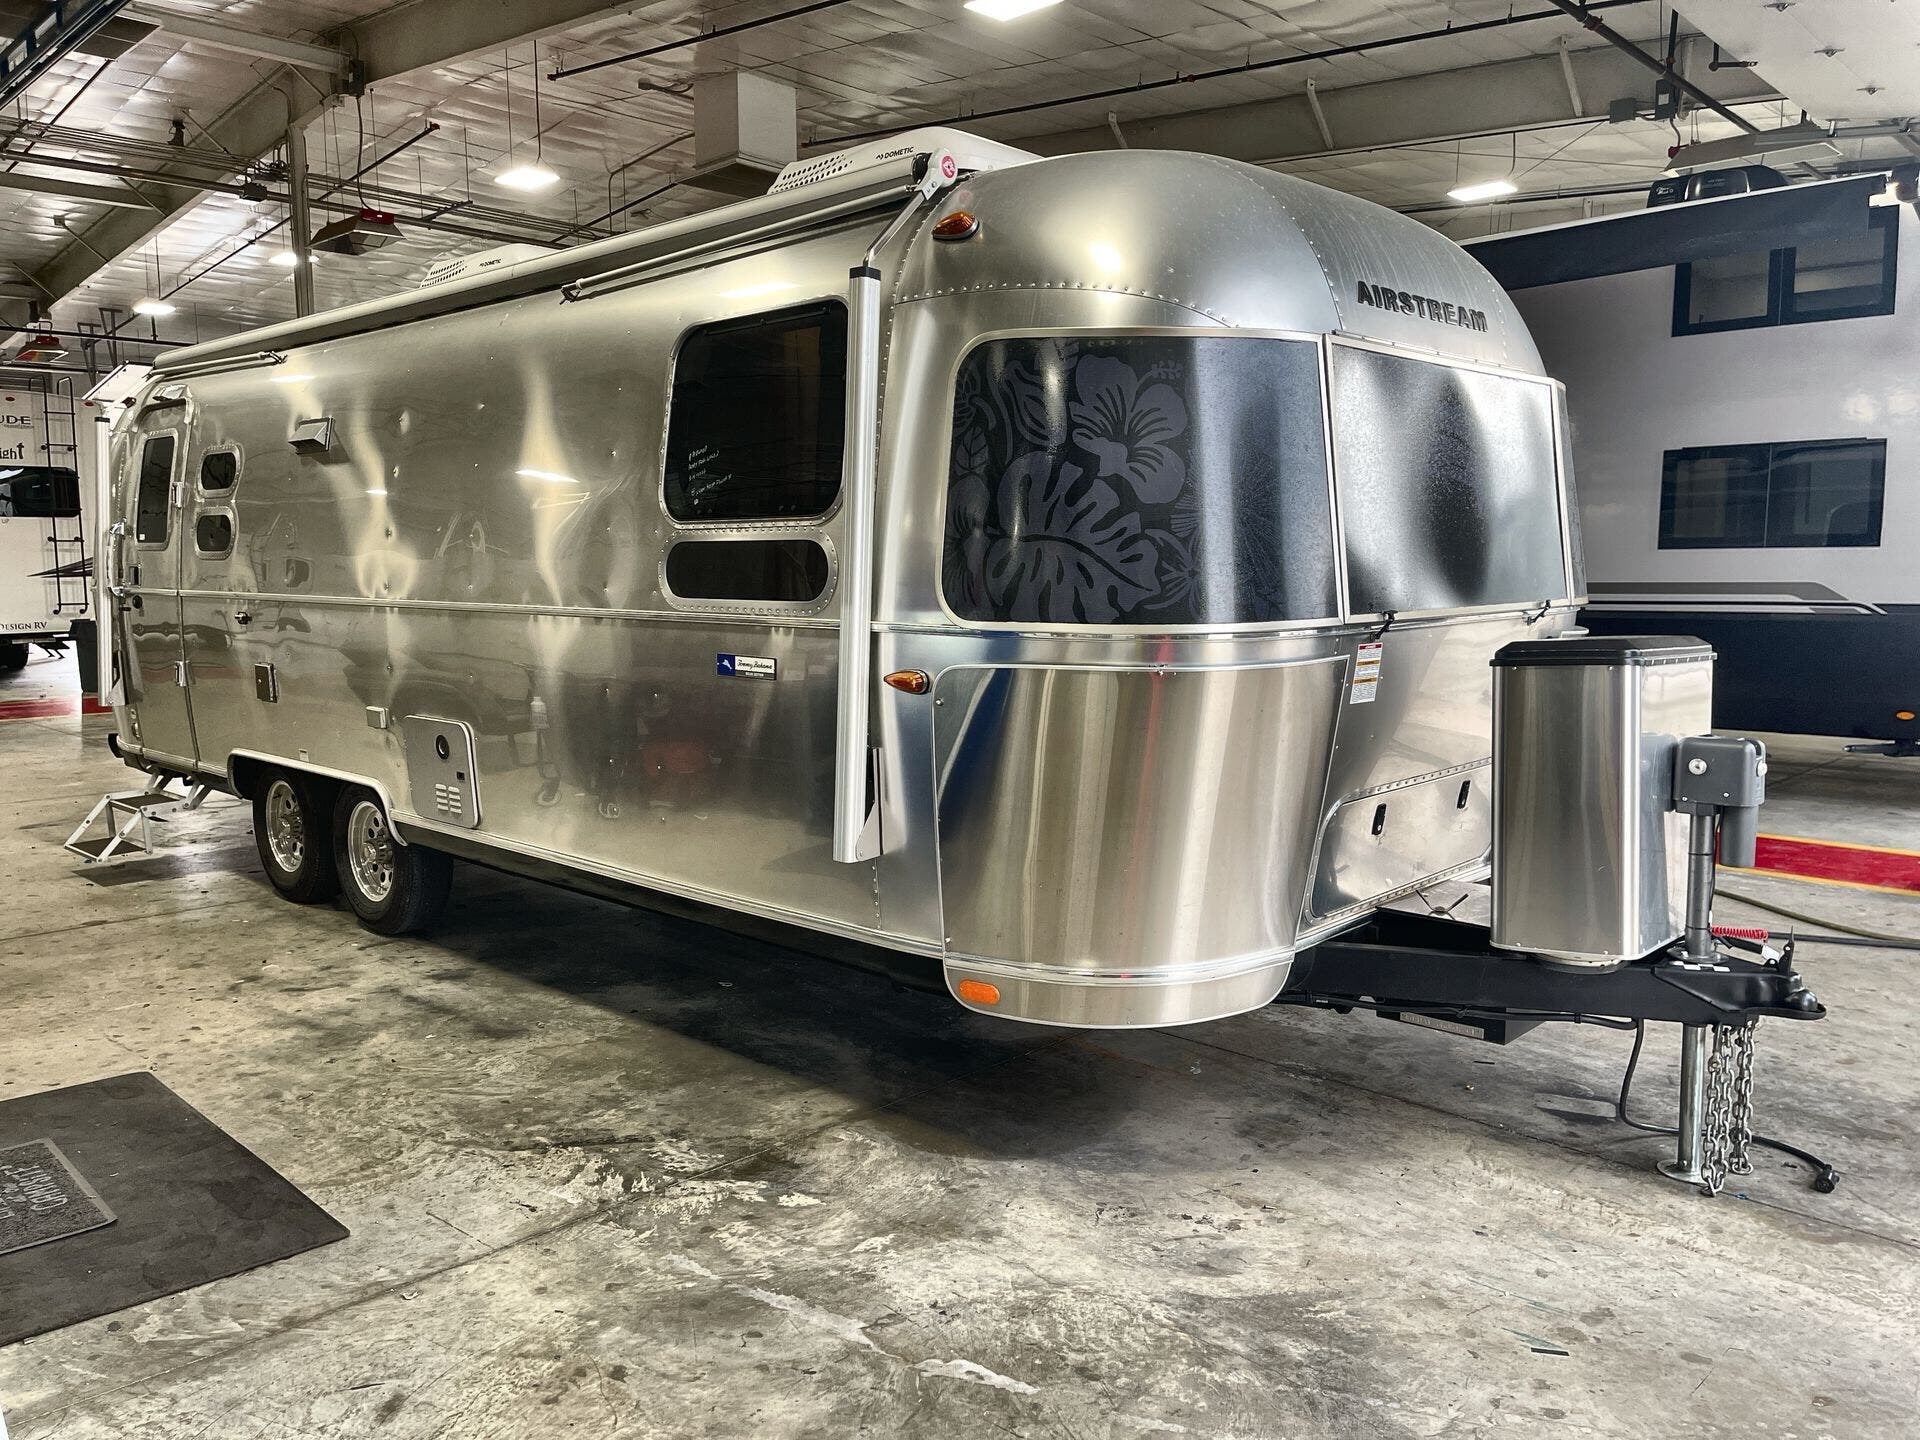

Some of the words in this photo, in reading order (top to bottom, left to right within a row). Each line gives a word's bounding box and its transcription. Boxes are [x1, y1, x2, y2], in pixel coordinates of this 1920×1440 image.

[884, 147, 914, 159] DOMETIC
[1357, 281, 1488, 333] AIRSTREAM
[34, 621, 47, 629] RV
[737, 659, 753, 669] Tommy
[753, 660, 773, 670] Bahama
